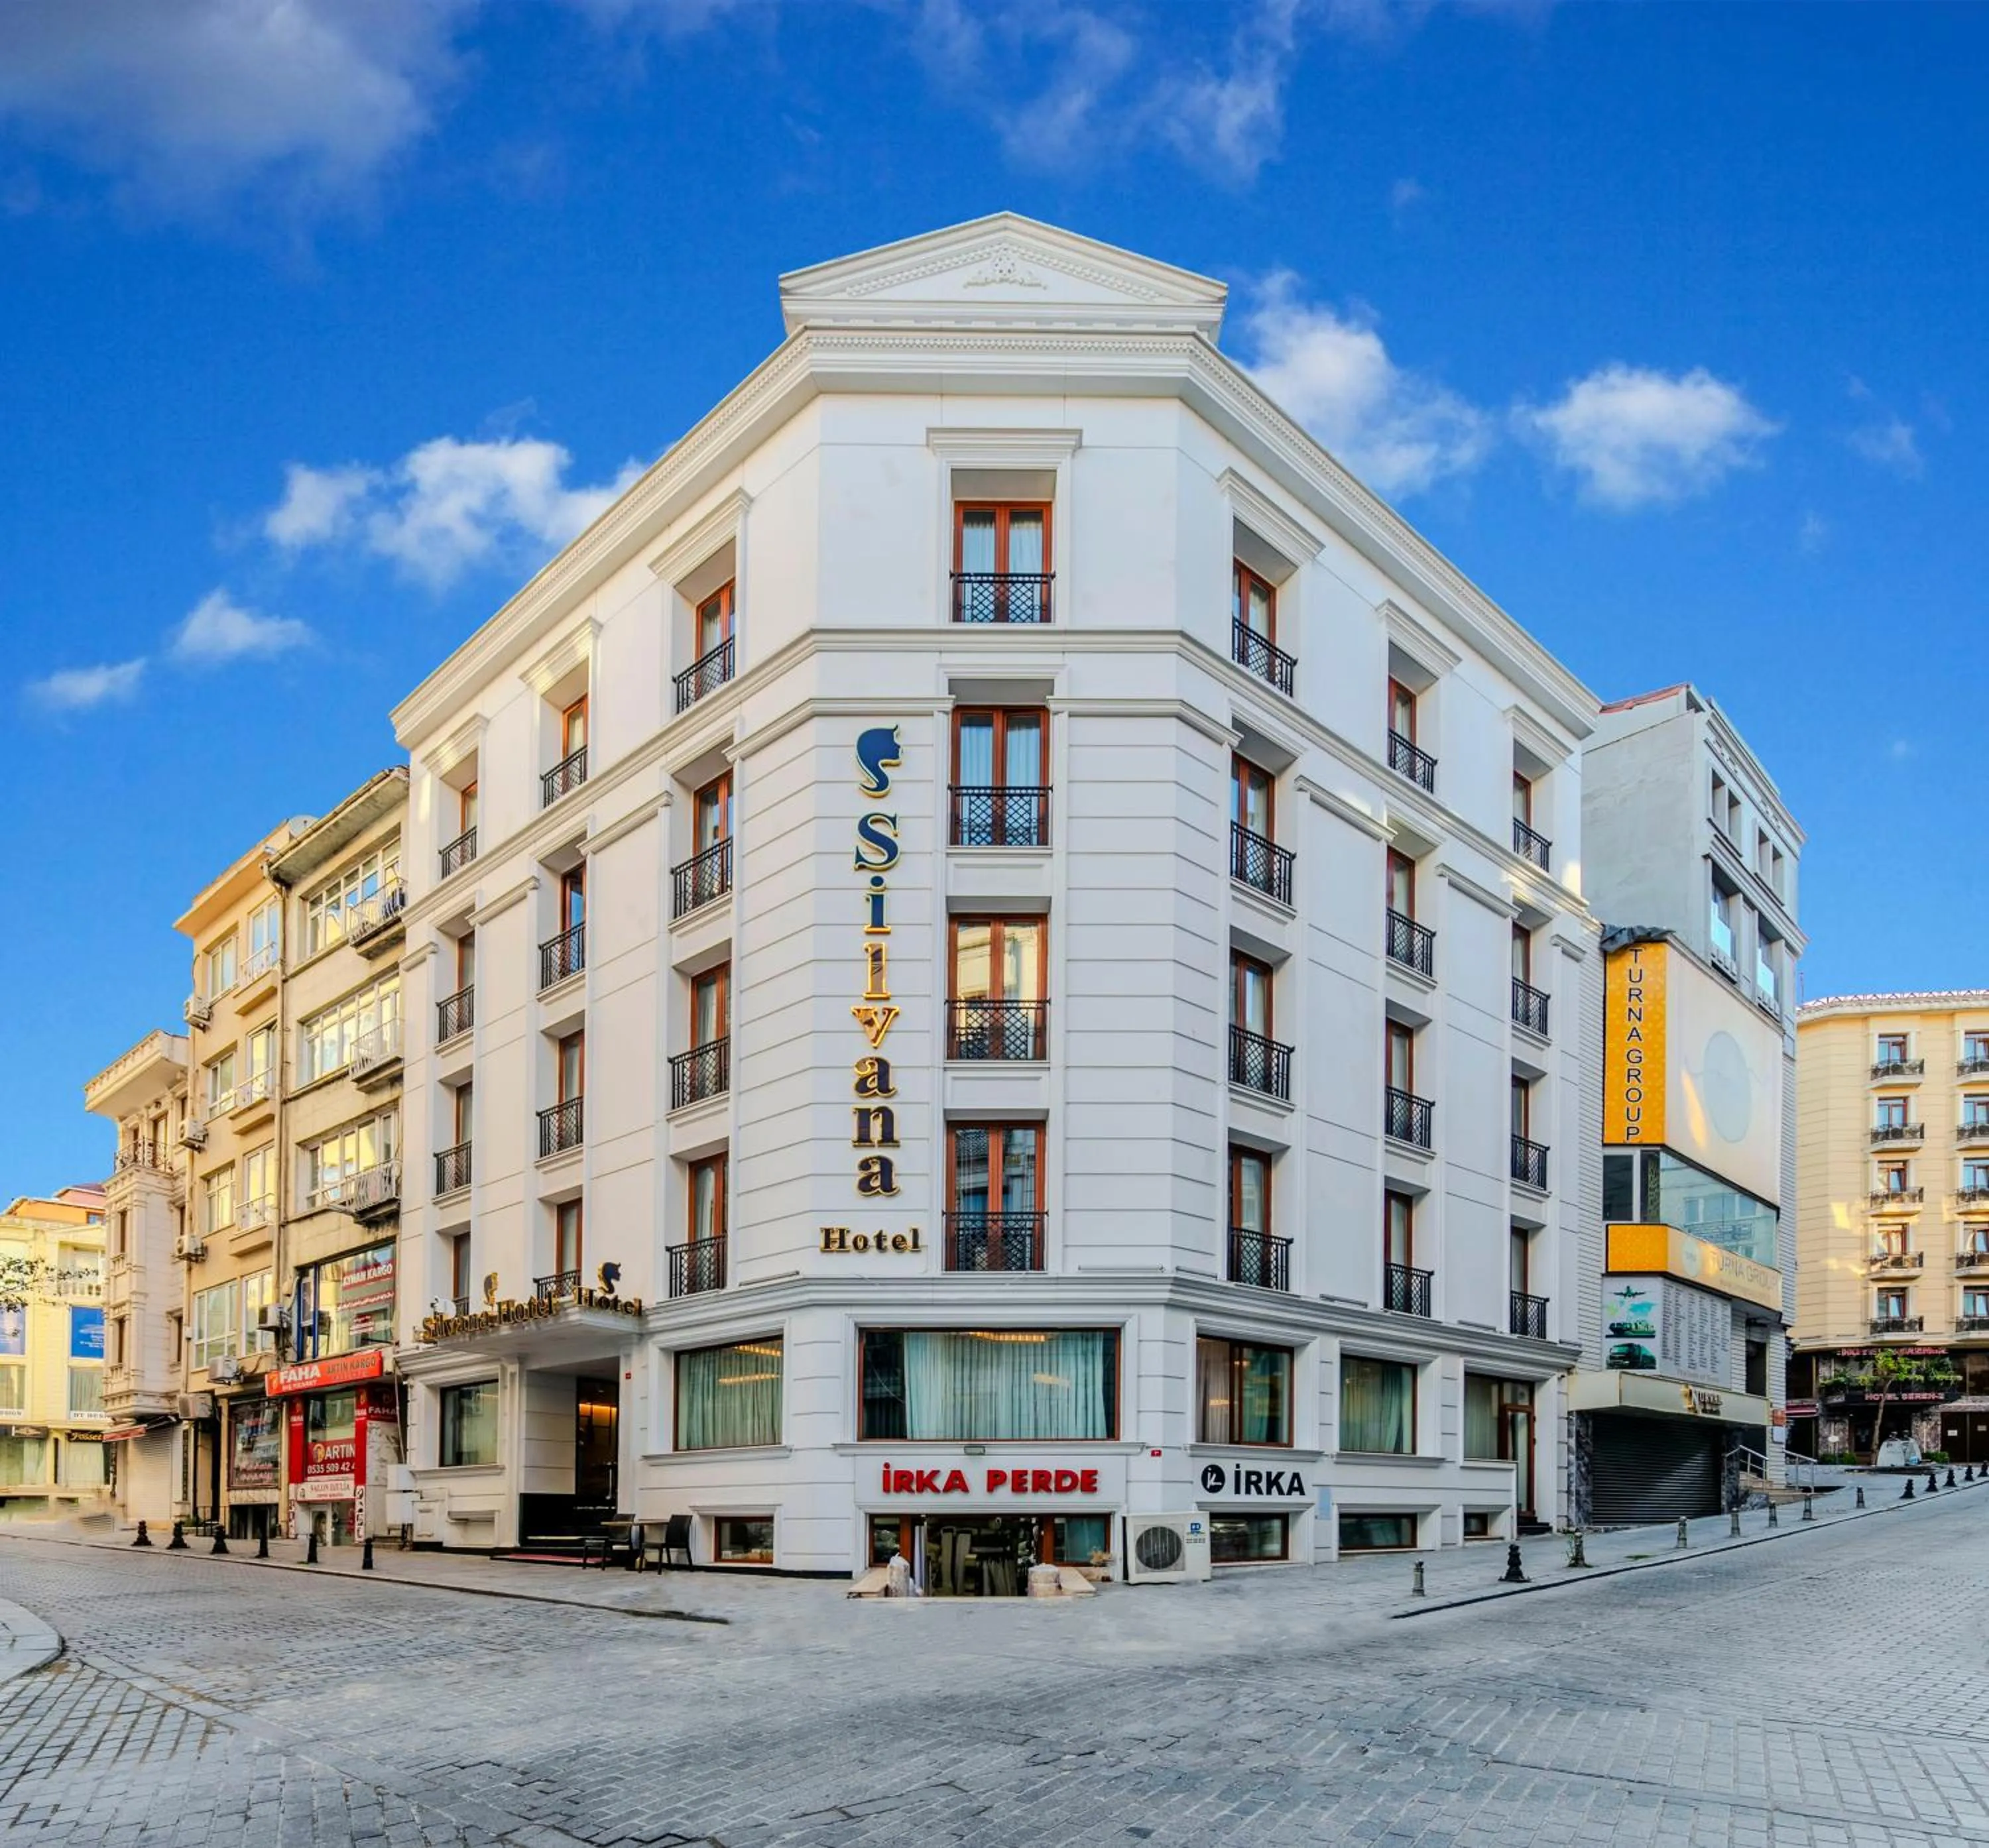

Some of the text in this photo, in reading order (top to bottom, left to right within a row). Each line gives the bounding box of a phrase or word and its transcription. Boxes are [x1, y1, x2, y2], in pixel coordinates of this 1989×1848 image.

[851, 812, 900, 1196] Silvana
[819, 1226, 922, 1252] Hotel
[367, 1263, 392, 1280] KARGO
[279, 1365, 322, 1385] FAHA
[369, 1405, 399, 1415] FAHA
[325, 1444, 355, 1461] ARTIN
[307, 1464, 324, 1475] 0535
[340, 1462, 351, 1472] 42
[882, 1462, 1099, 1494] İRKA PERDE
[1234, 1463, 1305, 1496] İRKA
